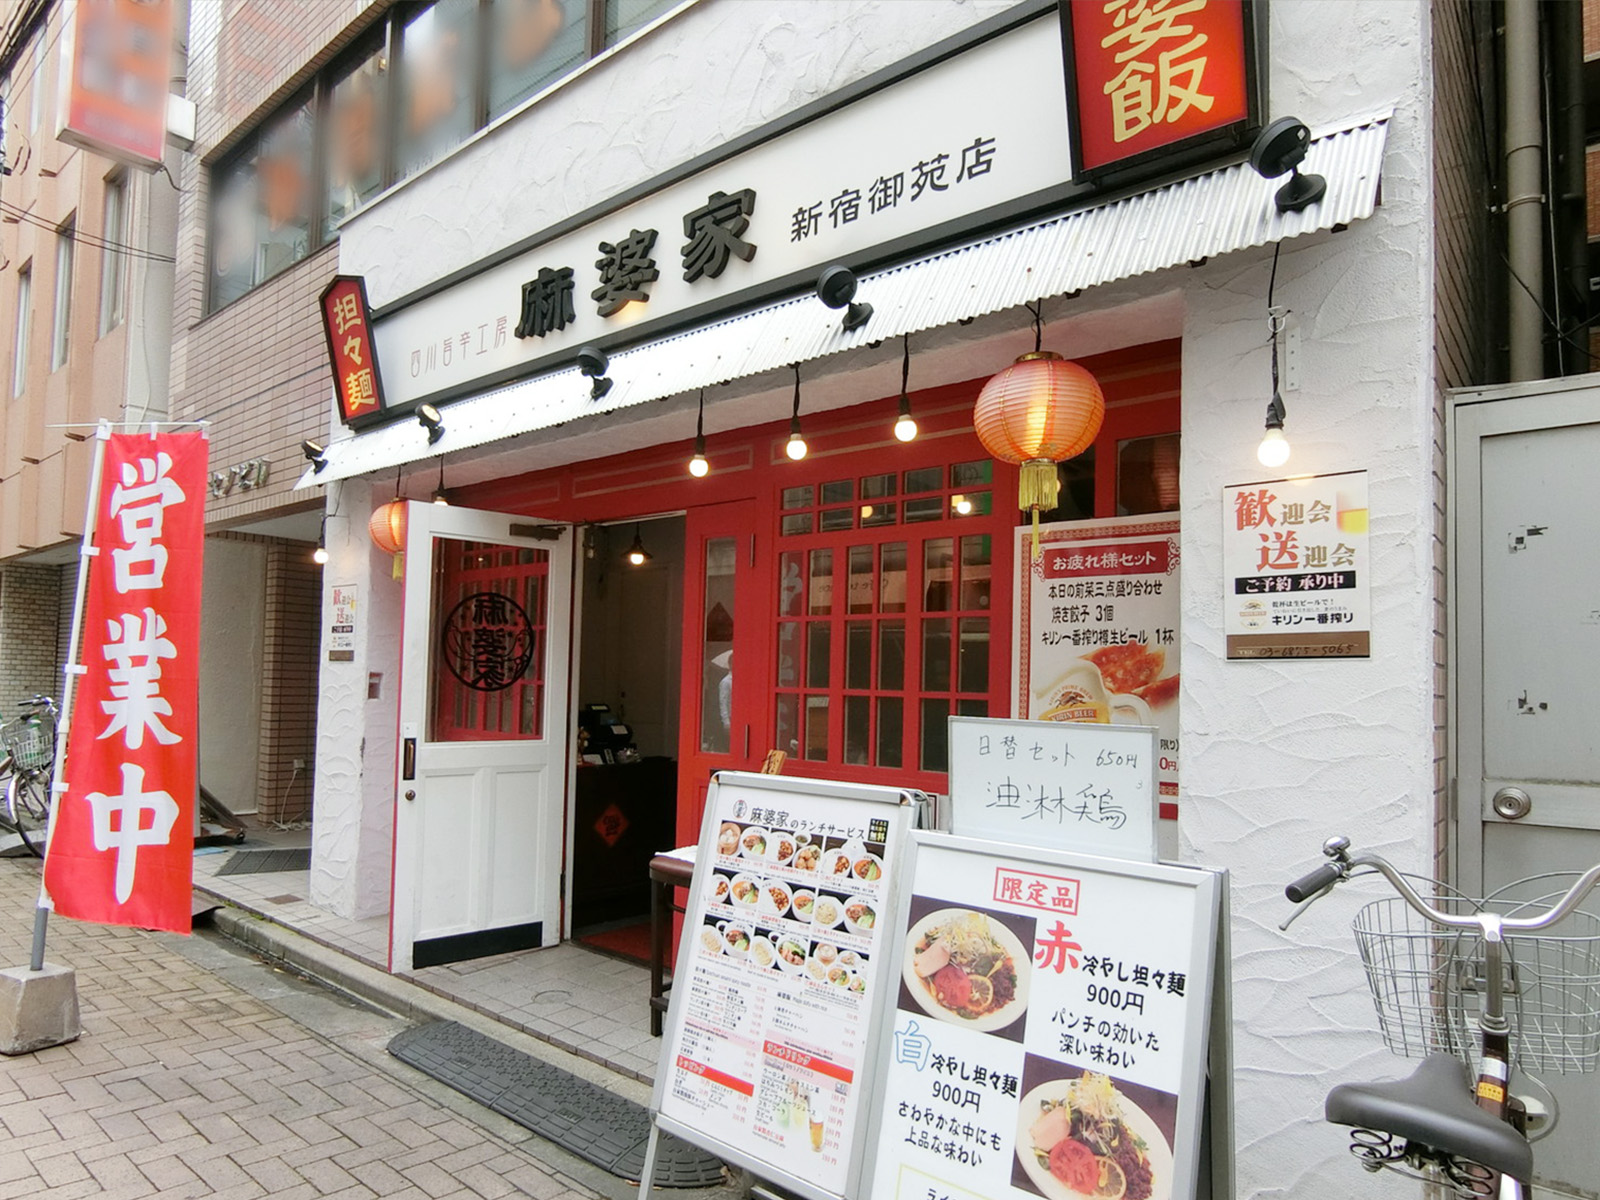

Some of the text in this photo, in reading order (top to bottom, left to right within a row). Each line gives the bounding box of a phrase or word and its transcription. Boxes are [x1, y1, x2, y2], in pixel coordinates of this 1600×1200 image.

[514, 188, 757, 340] 麻婆家
[791, 137, 996, 243] 新宿御苑店
[333, 293, 376, 411] 担々麺
[1053, 551, 1157, 571] お疲れ様セット
[1048, 580, 1163, 600] 本日の前菜三点盛り合わせ
[1246, 573, 1344, 592] ご予約 承り中
[1051, 604, 1114, 624] 焼き餃子 3個
[1272, 612, 1354, 626] キリン一番搾り
[1155, 627, 1175, 645] 1杯
[84, 451, 187, 905] 営業中
[1096, 749, 1138, 769] 650円
[750, 806, 865, 840] 麻婆家のランチサービス
[1001, 877, 1074, 908] 限定品
[1034, 920, 1082, 974] 赤
[1087, 984, 1144, 1015] 900円
[1052, 1007, 1160, 1052] パンチの効いた
[1059, 1033, 1135, 1069] 深い味わい
[932, 1080, 981, 1113] 900円
[898, 1101, 1001, 1151] さわやかな中にも
[904, 1126, 983, 1167] 上品な味わい
